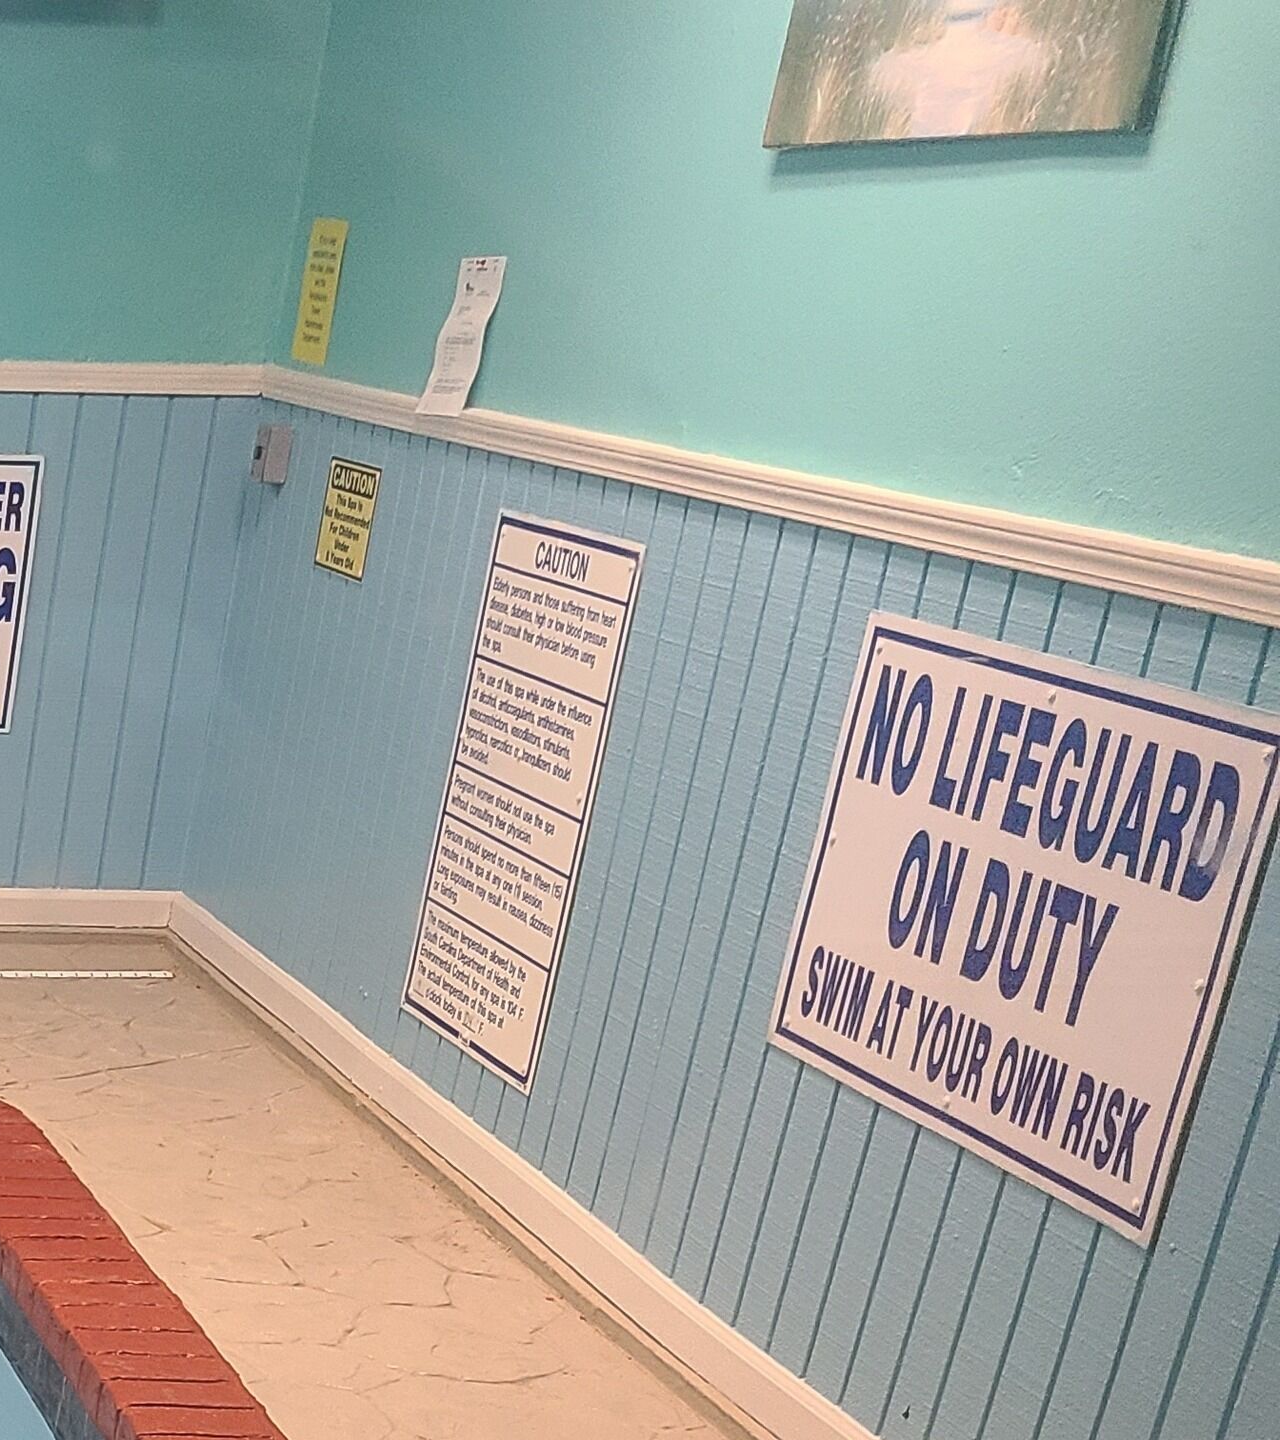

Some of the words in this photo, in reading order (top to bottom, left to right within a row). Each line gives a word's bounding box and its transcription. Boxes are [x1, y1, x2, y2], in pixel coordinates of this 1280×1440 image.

[333, 466, 375, 496] CAUTION
[535, 541, 590, 582] CAUTION
[856, 664, 933, 795] NO
[929, 687, 1240, 902] LIFEGUARD
[889, 830, 969, 965] ON
[960, 858, 1119, 1026] DUTY
[801, 946, 875, 1042] SWIM
[866, 980, 914, 1059] AT
[910, 996, 992, 1103] YOUR
[991, 1037, 1068, 1140] OWN
[1060, 1072, 1151, 1183] RISK
